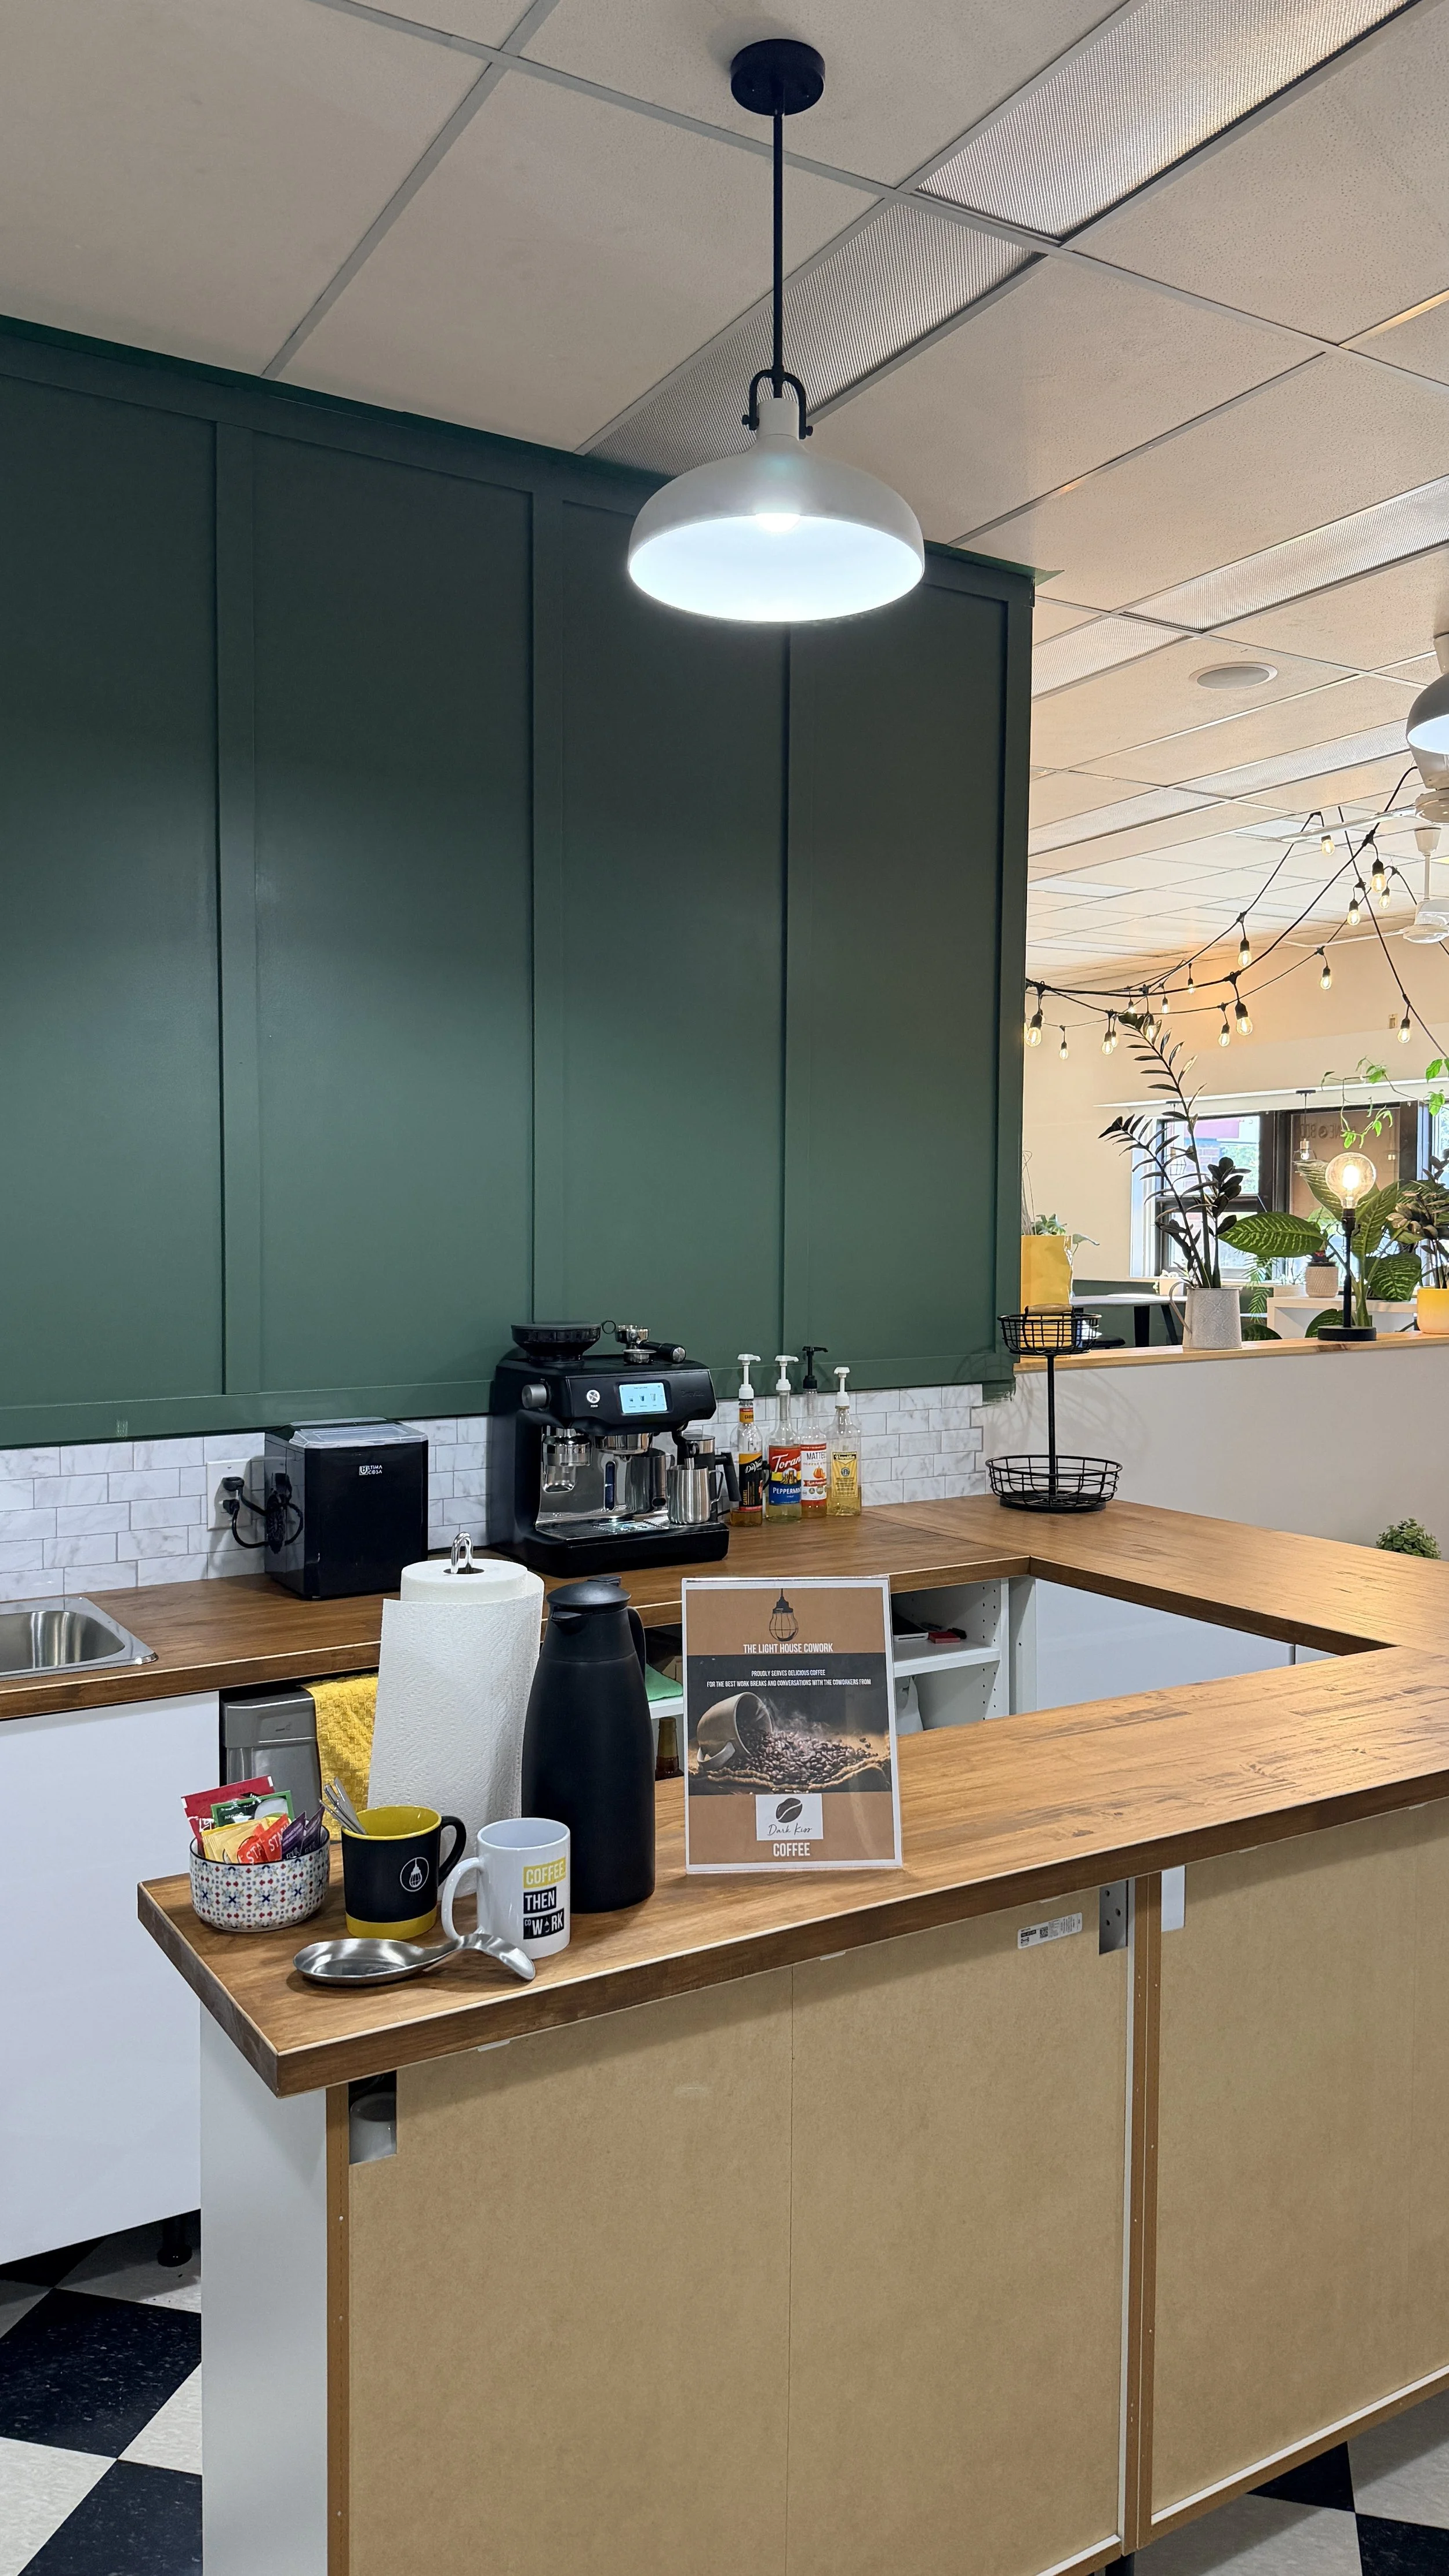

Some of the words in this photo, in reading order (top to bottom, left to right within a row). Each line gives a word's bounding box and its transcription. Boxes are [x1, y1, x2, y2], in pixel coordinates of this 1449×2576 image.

[743, 1644, 757, 1654] THE
[758, 1643, 778, 1653] LIGHT
[779, 1643, 802, 1653] HOUSE
[803, 1643, 833, 1653] COWORK
[767, 1824, 791, 1836] Dark
[793, 1822, 813, 1836] Kiss
[773, 1842, 811, 1857] COFFEE
[525, 1890, 555, 1911] THEN
